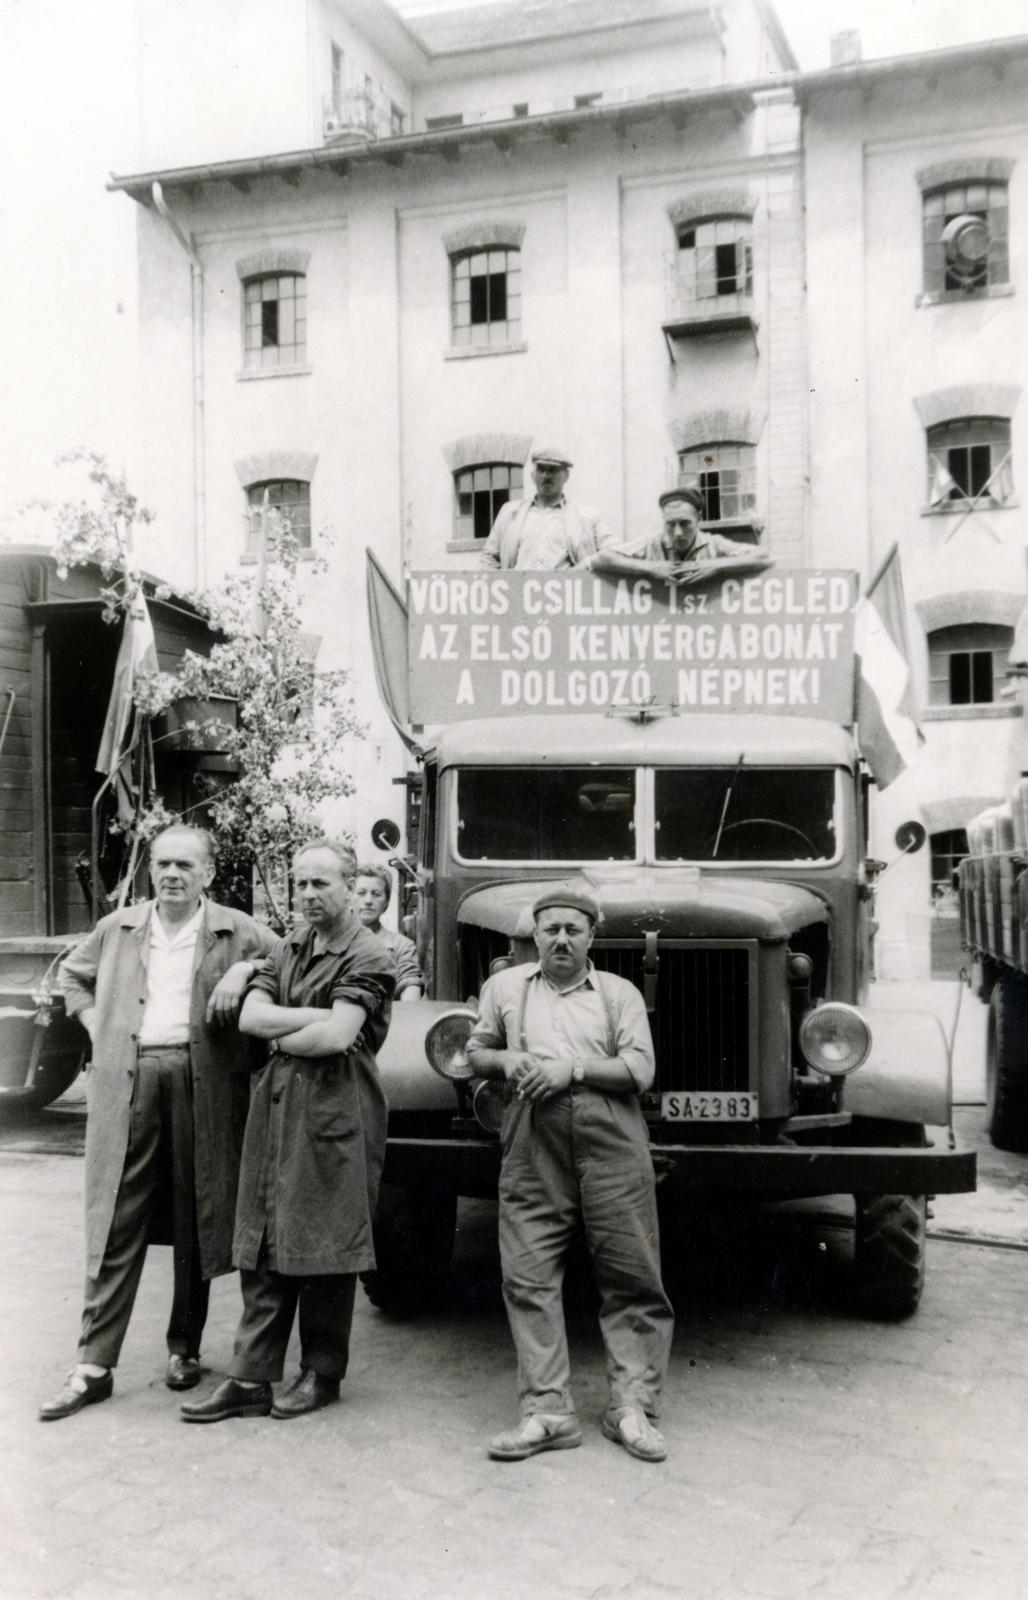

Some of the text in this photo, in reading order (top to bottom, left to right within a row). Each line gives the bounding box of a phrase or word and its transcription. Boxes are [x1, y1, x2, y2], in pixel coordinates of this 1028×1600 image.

[410, 574, 510, 615] VÖRÖS
[522, 578, 653, 615] CSILLAG
[418, 617, 844, 661] AZ ELSŐ KENYÉRGABONÁT
[456, 663, 820, 706] A DOLGOZÓ NÉPNEK!
